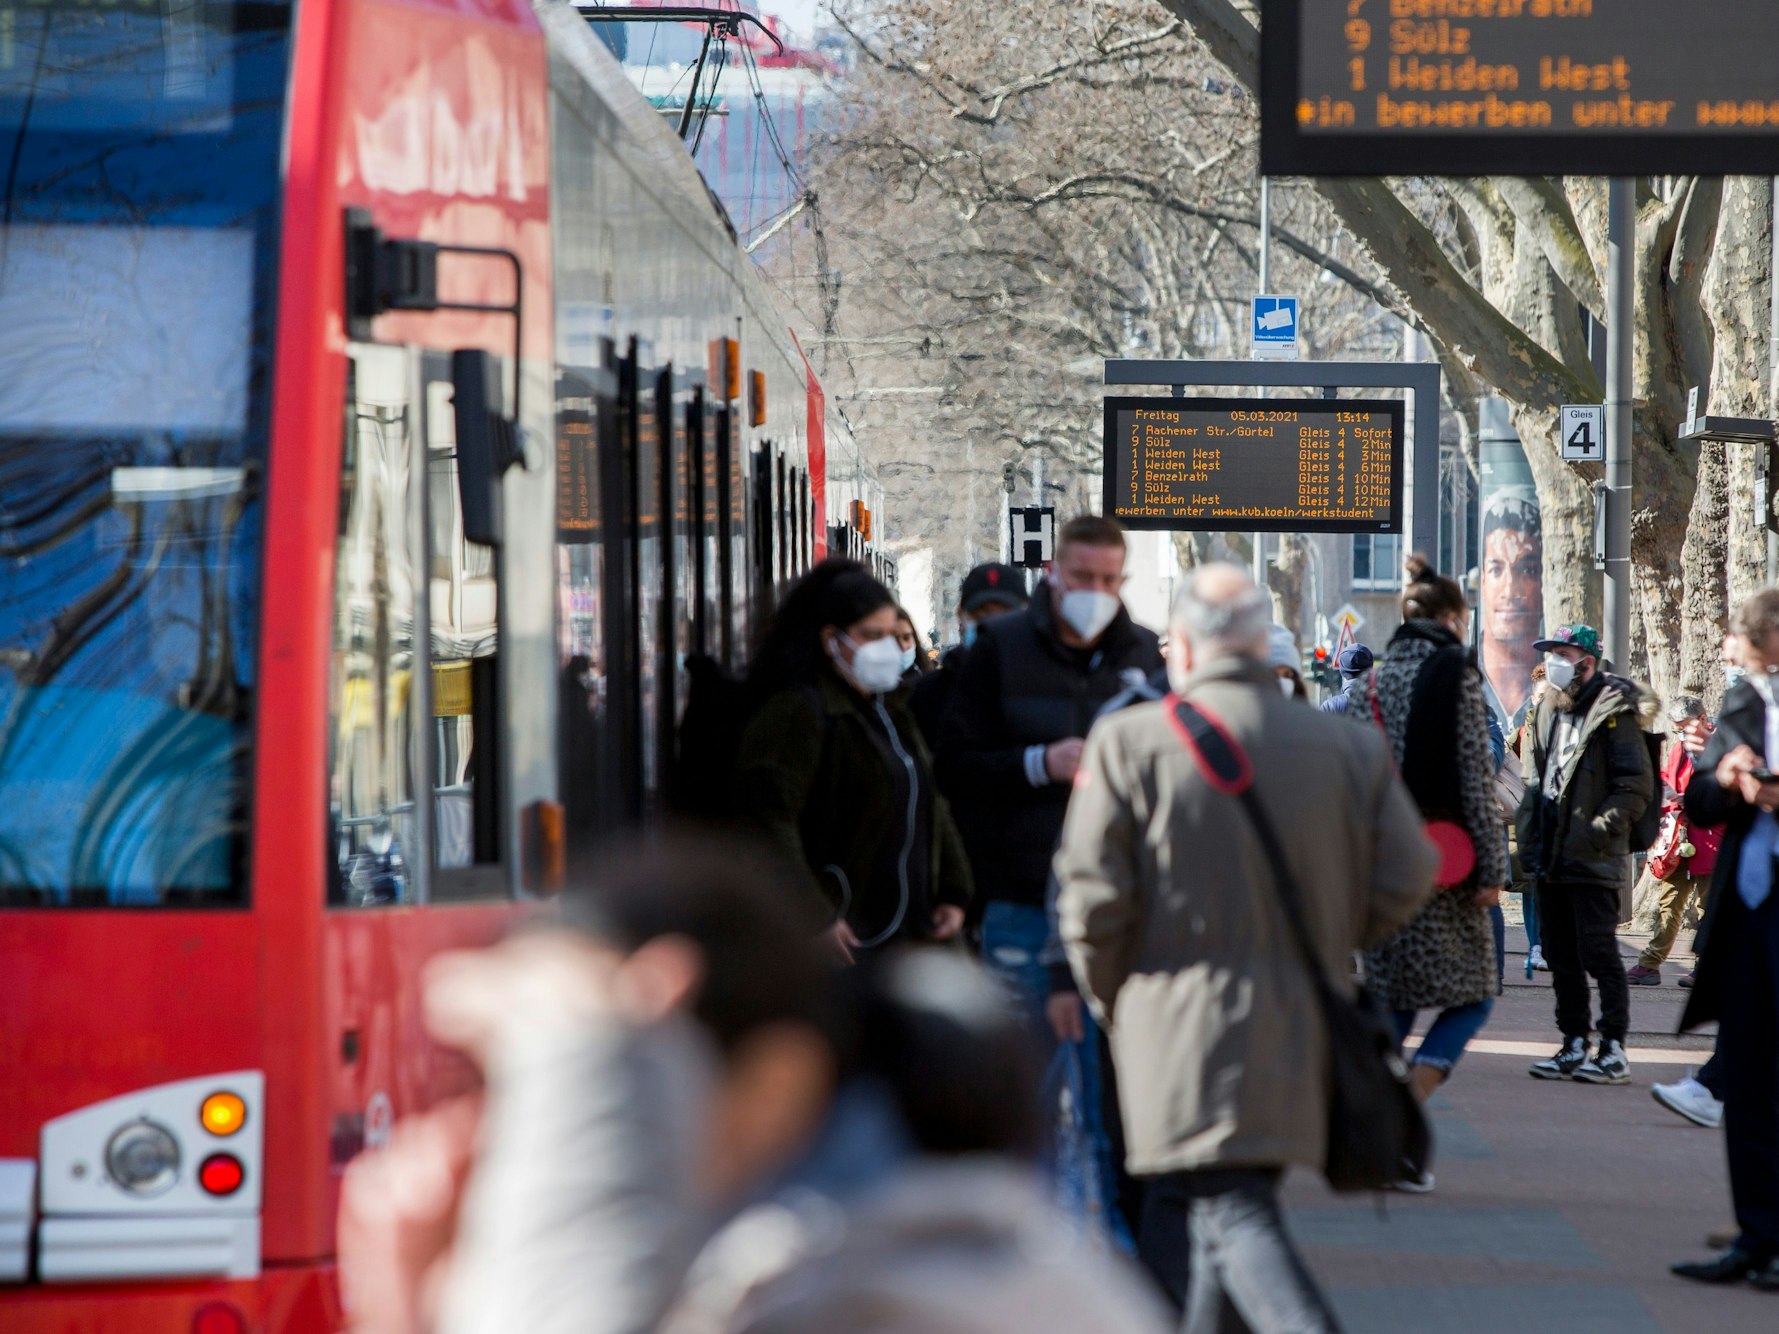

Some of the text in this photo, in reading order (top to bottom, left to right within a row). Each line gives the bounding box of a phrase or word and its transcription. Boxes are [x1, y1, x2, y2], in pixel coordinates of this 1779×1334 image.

[1345, 19, 1471, 54] 9 Sülz
[1348, 57, 1630, 91] 1 Weiden West
[1377, 93, 1552, 127] bewerben
[1572, 94, 1675, 127] unter
[1135, 410, 1369, 422] Freitag 05.03.2021 13:14
[1570, 410, 1593, 419] Gleis
[1132, 425, 1392, 440] 7 Aachener Str./Gürtel Gleis 4 Sofort
[1568, 422, 1596, 454] 4
[1132, 436, 1391, 449] 9 Sülz Gleis 4 2 Min
[1132, 448, 1391, 461] 1 Weiden West Gleis 4 3 Min
[1132, 460, 1391, 472] 1 Weiden West Gleis 4 6 Min
[1131, 471, 1390, 484] 7 Benzelrath Gleis 4 10 Min
[1131, 483, 1390, 495] 9 Sülz Gleis 4 10 Min
[1132, 494, 1390, 506] 1 Weiden West Gleis 4 12 Min
[1173, 506, 1204, 516] unter
[1212, 506, 1373, 518] www.kvb.koeln/werkstudent
[1012, 514, 1052, 562] H
